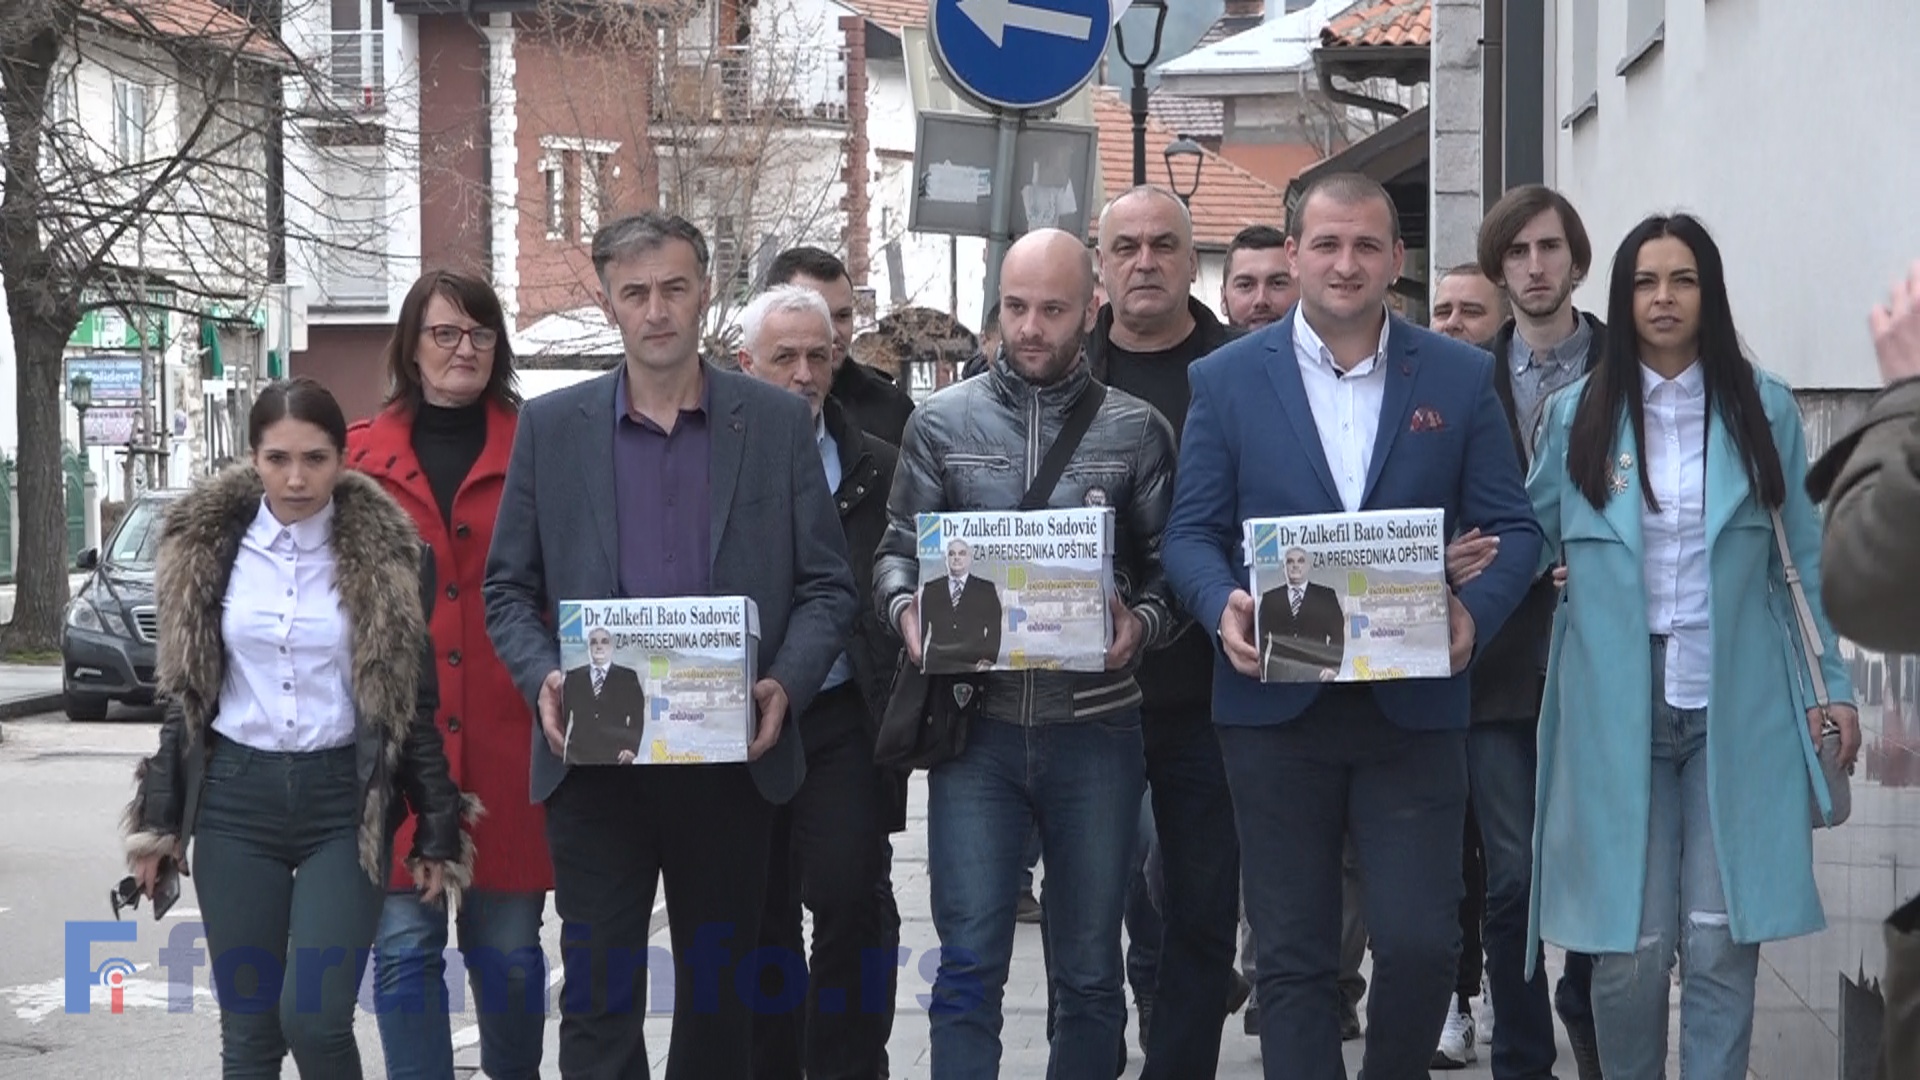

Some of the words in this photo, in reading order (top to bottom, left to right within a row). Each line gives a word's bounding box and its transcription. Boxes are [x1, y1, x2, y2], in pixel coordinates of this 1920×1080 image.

[943, 518, 959, 538] Dr
[962, 517, 1011, 537] Zulkefil
[1014, 517, 1044, 537] Bato
[1047, 515, 1097, 536] Sadović
[1280, 527, 1297, 547] Dr
[1300, 524, 1350, 545] Zulkefil
[1353, 521, 1384, 541] Bato
[1387, 518, 1438, 539] Sadović
[973, 544, 987, 561] ZA
[988, 543, 1055, 560] PREDSEDNIKA
[1057, 539, 1098, 559] OPŠTINE
[1312, 552, 1326, 569] ZA
[1327, 549, 1396, 568] PREDSEDNIKA
[1398, 543, 1439, 564] OPŠTINE
[584, 608, 600, 627] Dr
[604, 607, 653, 626] Zulkefil
[657, 606, 687, 625] Bato
[690, 605, 741, 625] Sadović
[615, 633, 630, 650] ZA
[631, 632, 698, 649] PREDSEDNIKA
[700, 629, 742, 649] OPŠTINE
